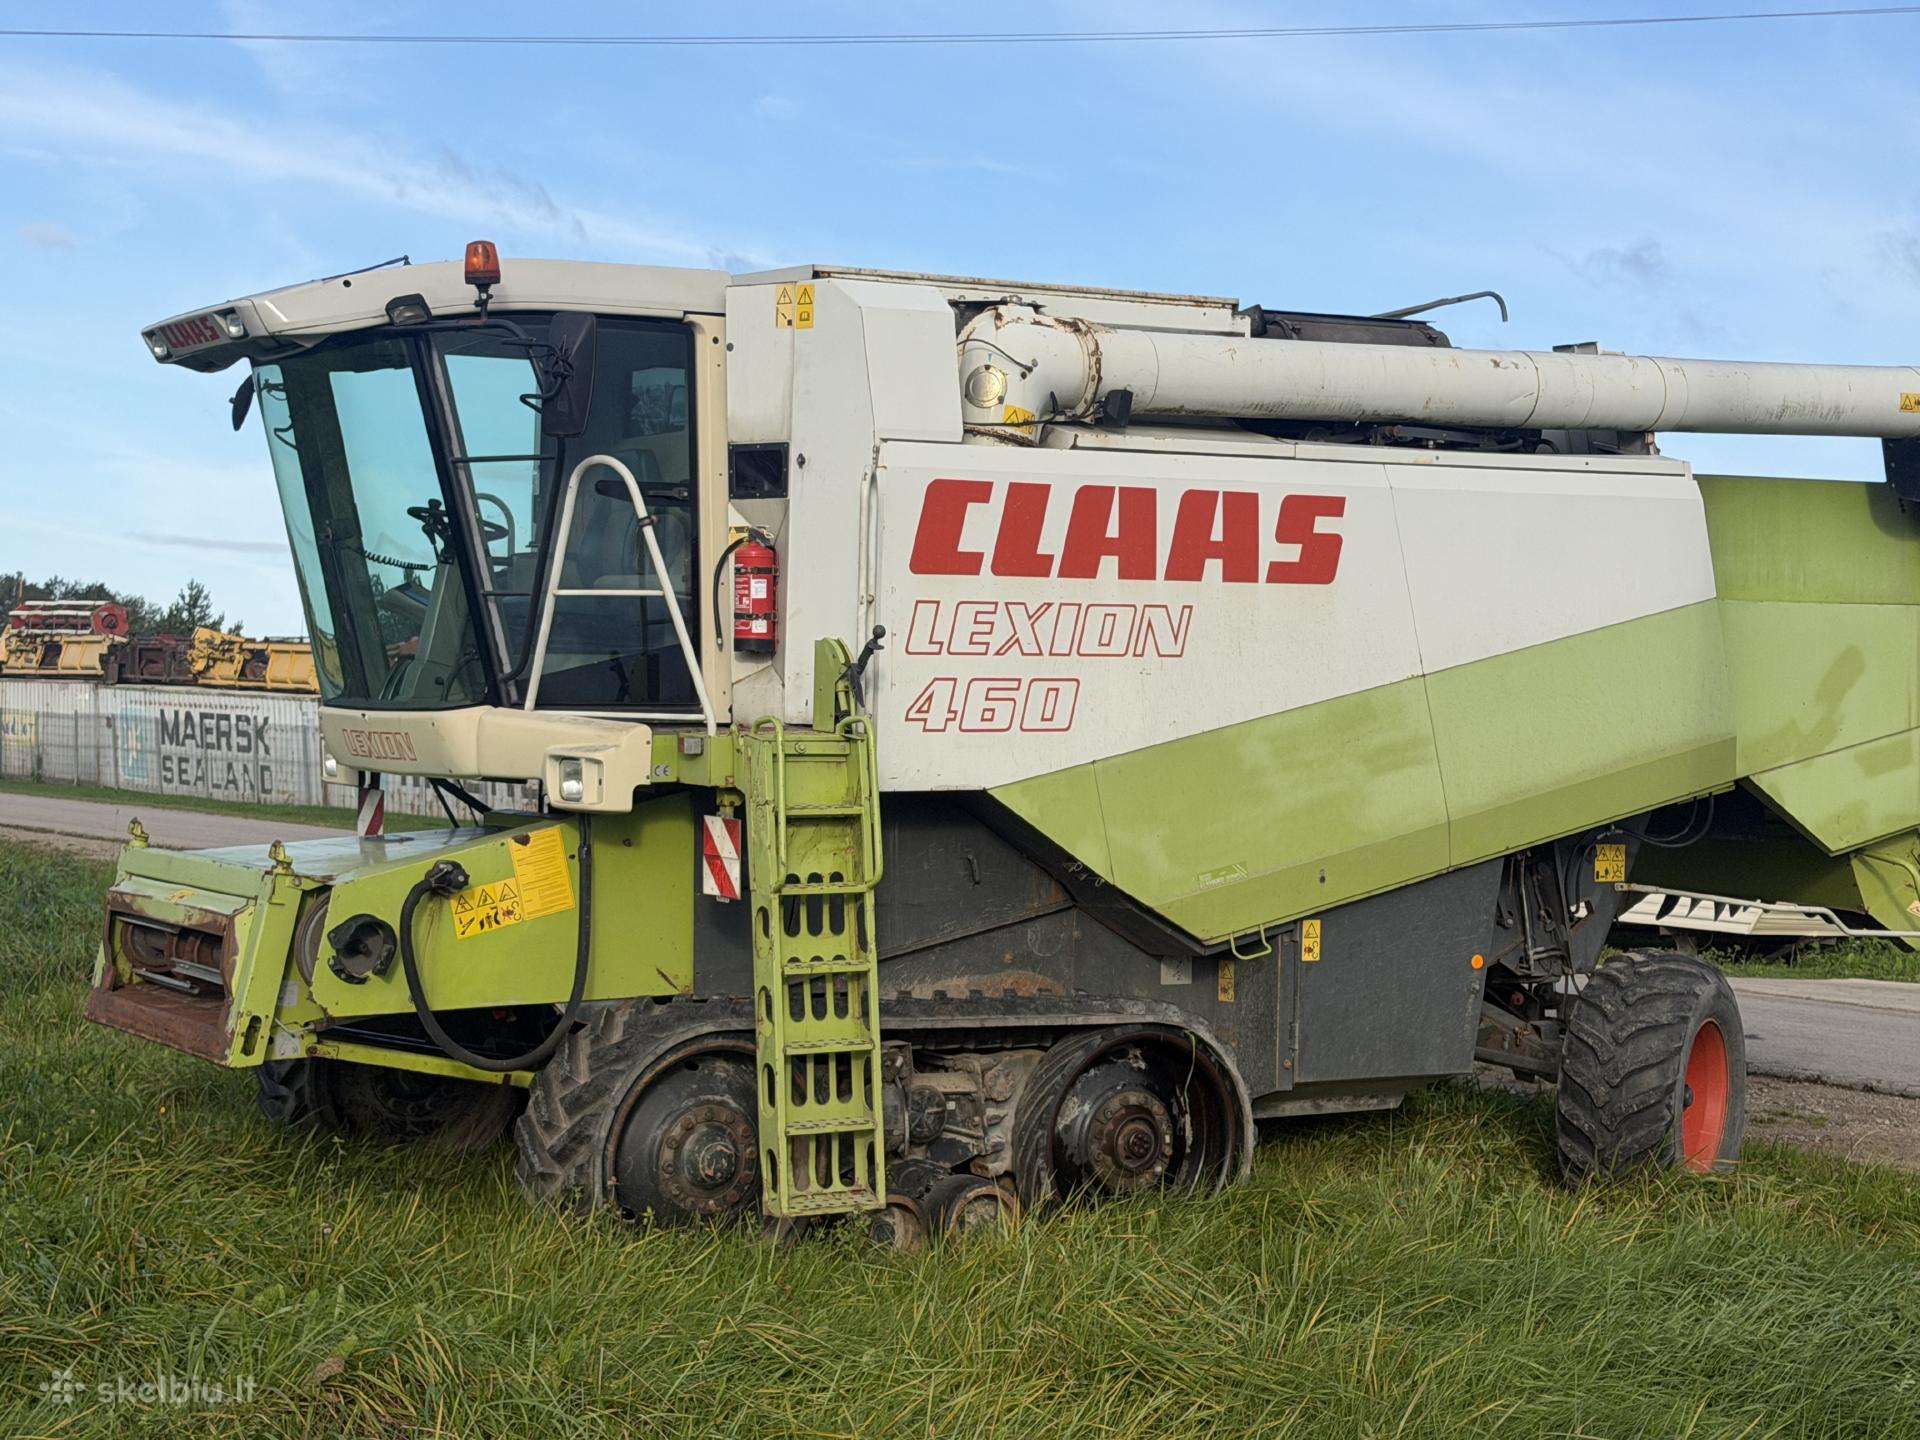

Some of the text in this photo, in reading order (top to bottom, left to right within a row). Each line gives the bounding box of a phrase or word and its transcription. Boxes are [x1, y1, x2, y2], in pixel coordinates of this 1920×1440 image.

[909, 478, 1346, 585] CLAAS
[905, 599, 1194, 659] LEXION
[905, 677, 1081, 733] 460
[160, 709, 271, 756] MAERSK
[342, 728, 418, 762] LEXION
[161, 755, 273, 796] SEALAND
[654, 764, 673, 777] CE
